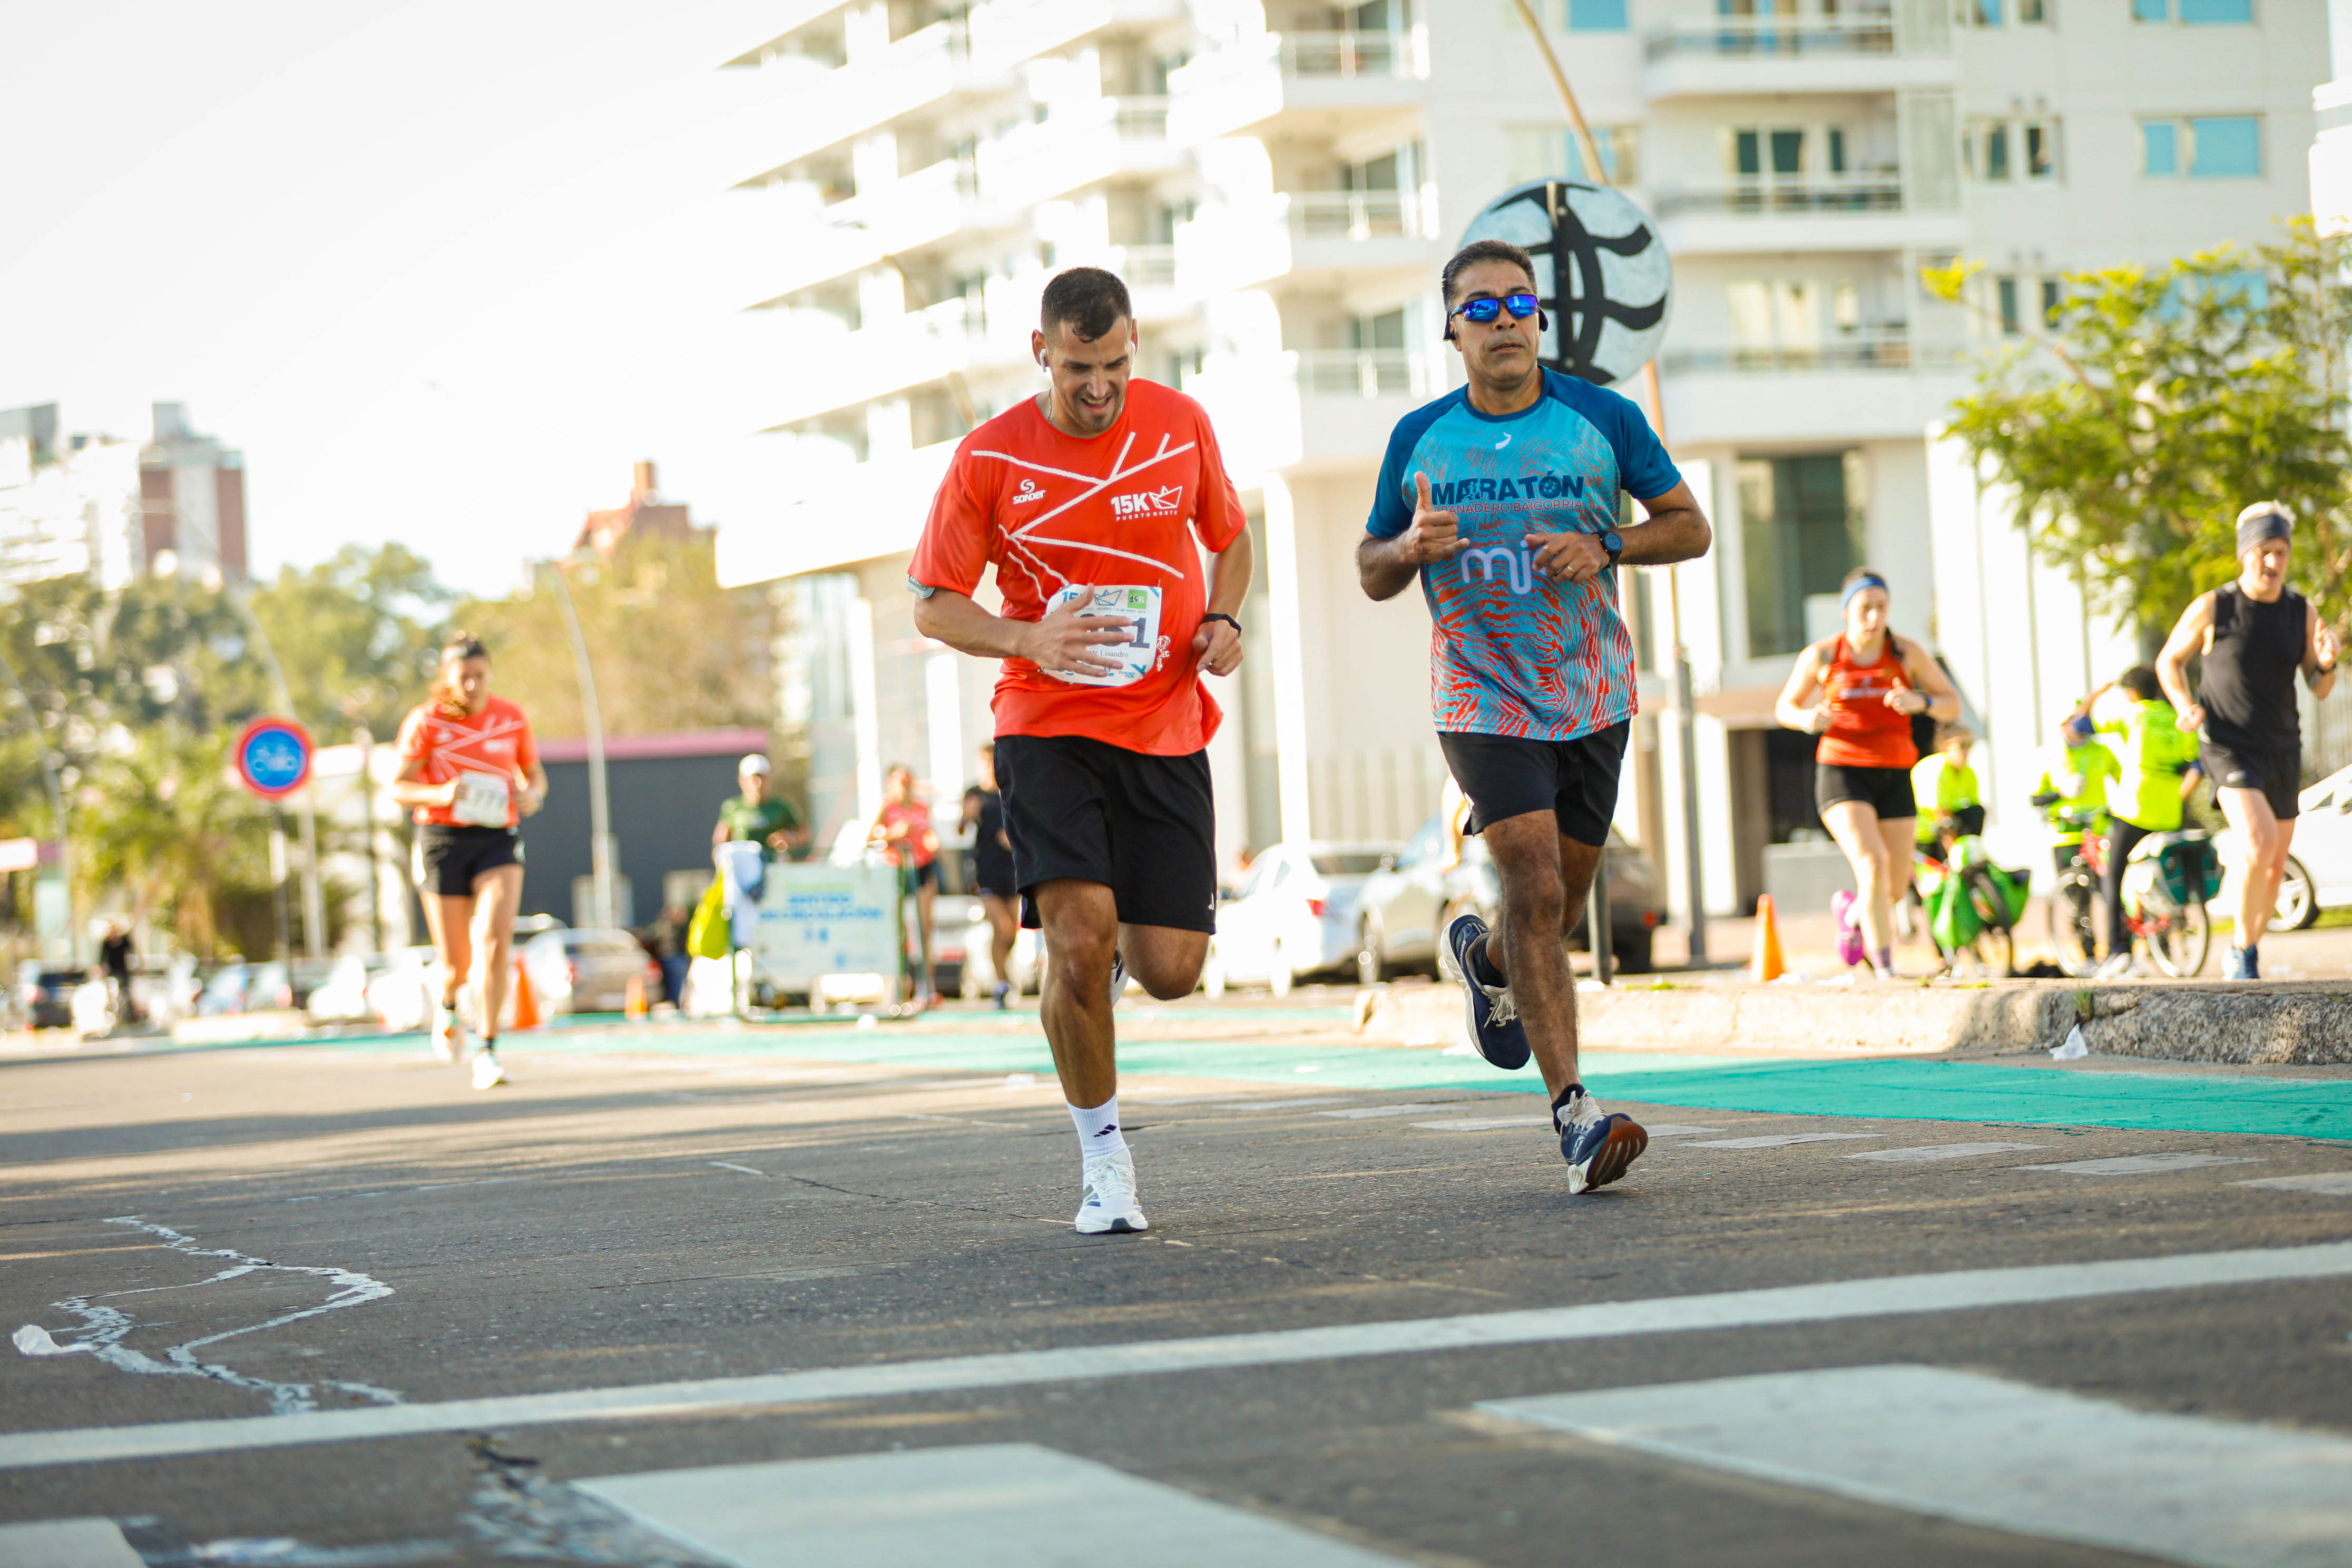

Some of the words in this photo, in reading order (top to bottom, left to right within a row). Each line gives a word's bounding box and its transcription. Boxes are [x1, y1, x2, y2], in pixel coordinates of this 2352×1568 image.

[1431, 470, 1585, 505] MARATÓN
[1111, 493, 1150, 515] 15K
[1513, 499, 1582, 512] BAIGORRIA
[1116, 512, 1150, 522] PUERTO
[1100, 649, 1129, 658] Lisandro
